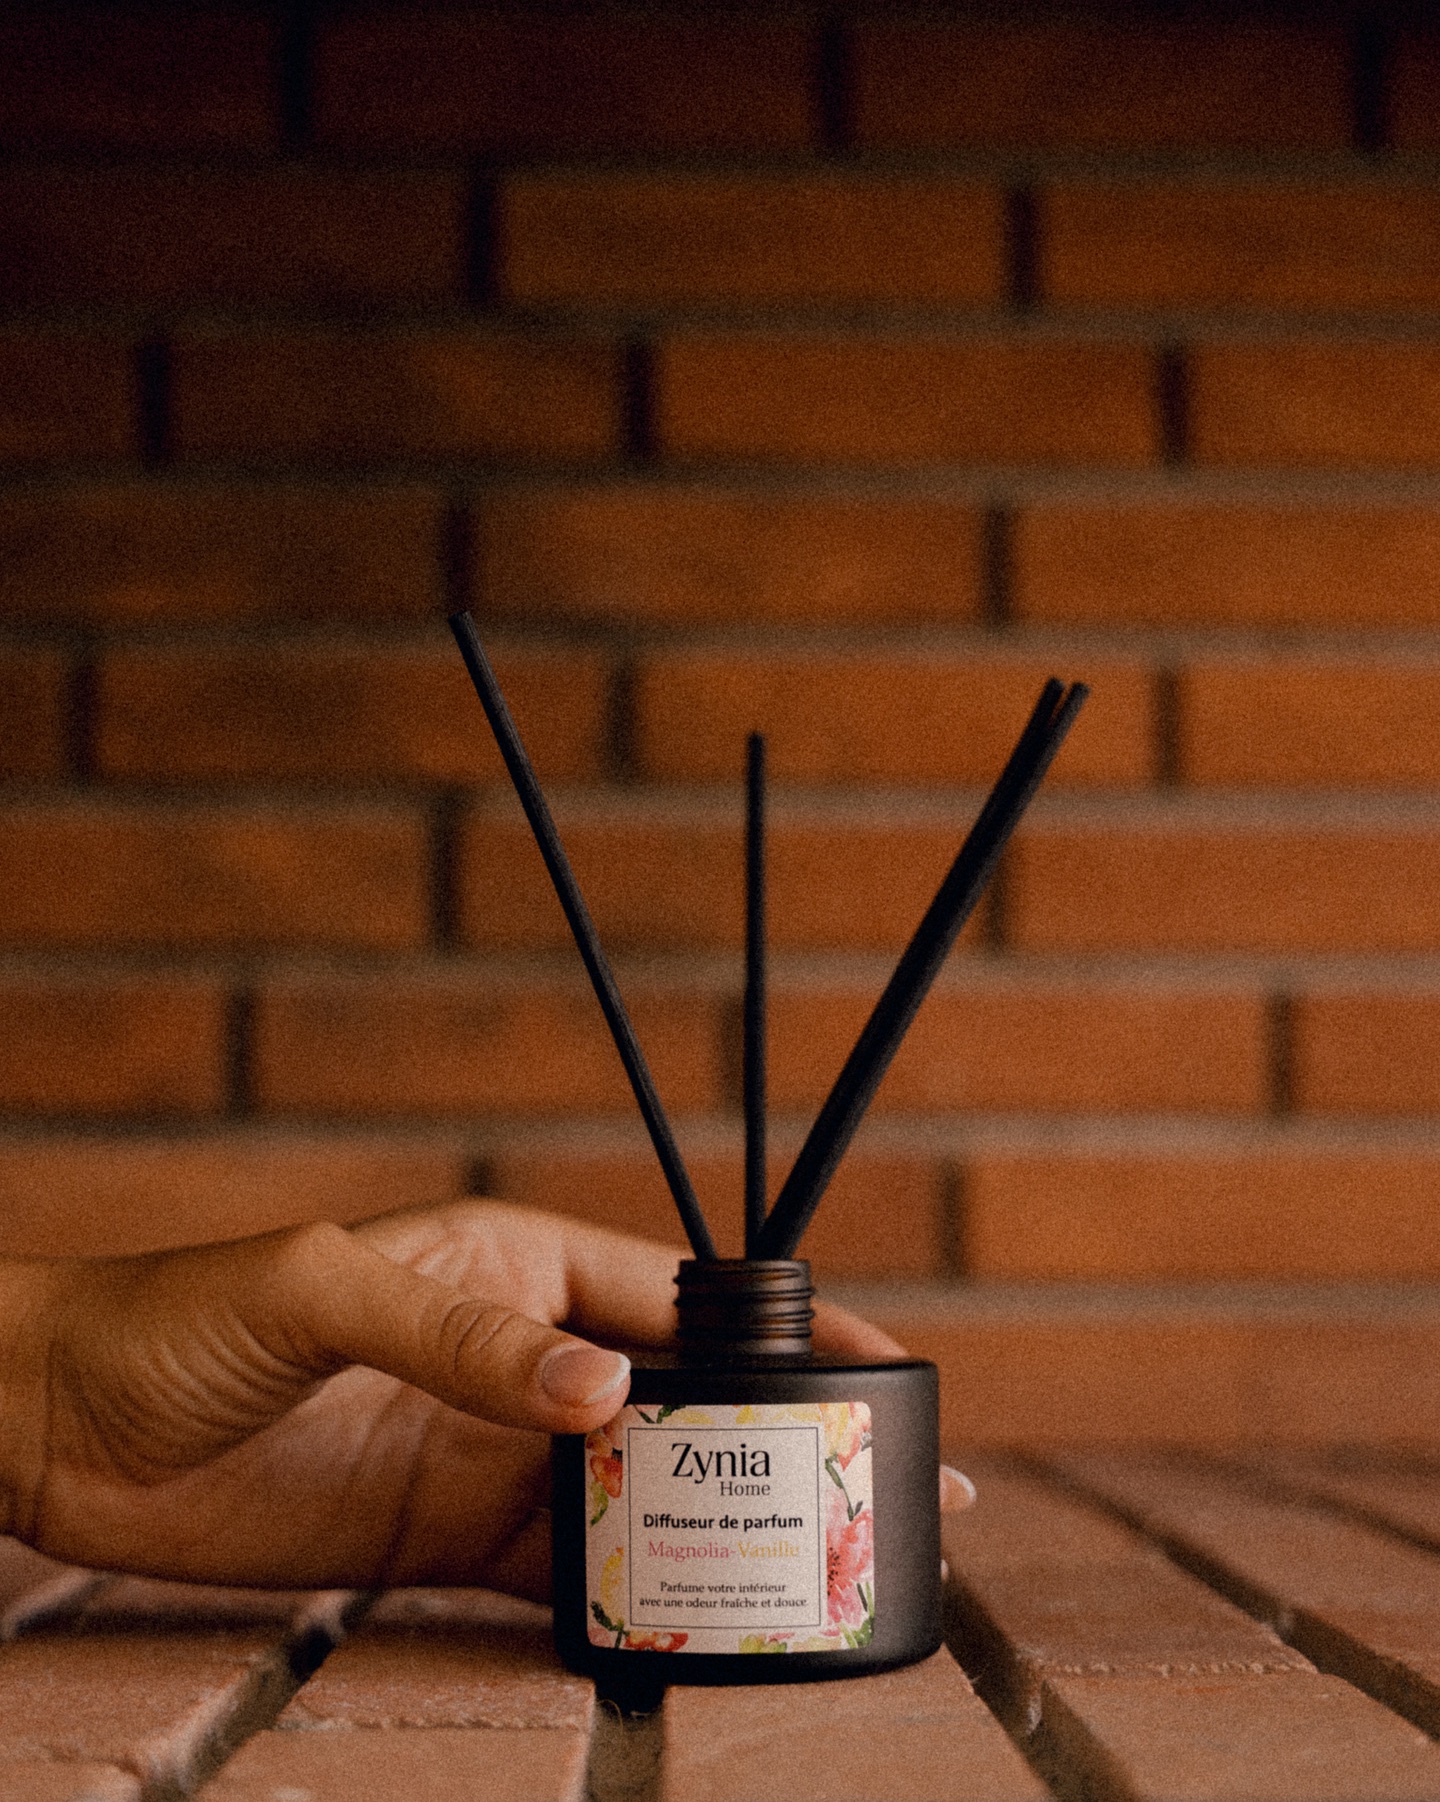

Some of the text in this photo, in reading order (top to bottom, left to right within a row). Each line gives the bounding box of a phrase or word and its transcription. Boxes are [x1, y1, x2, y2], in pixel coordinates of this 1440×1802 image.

[671, 1443, 771, 1484] Zynia
[720, 1482, 771, 1496] Home
[643, 1514, 803, 1532] Diffuseur de parfum
[660, 1581, 786, 1593] Parfume votre intérieur
[639, 1597, 807, 1608] avec une odeur fraîche et douce
